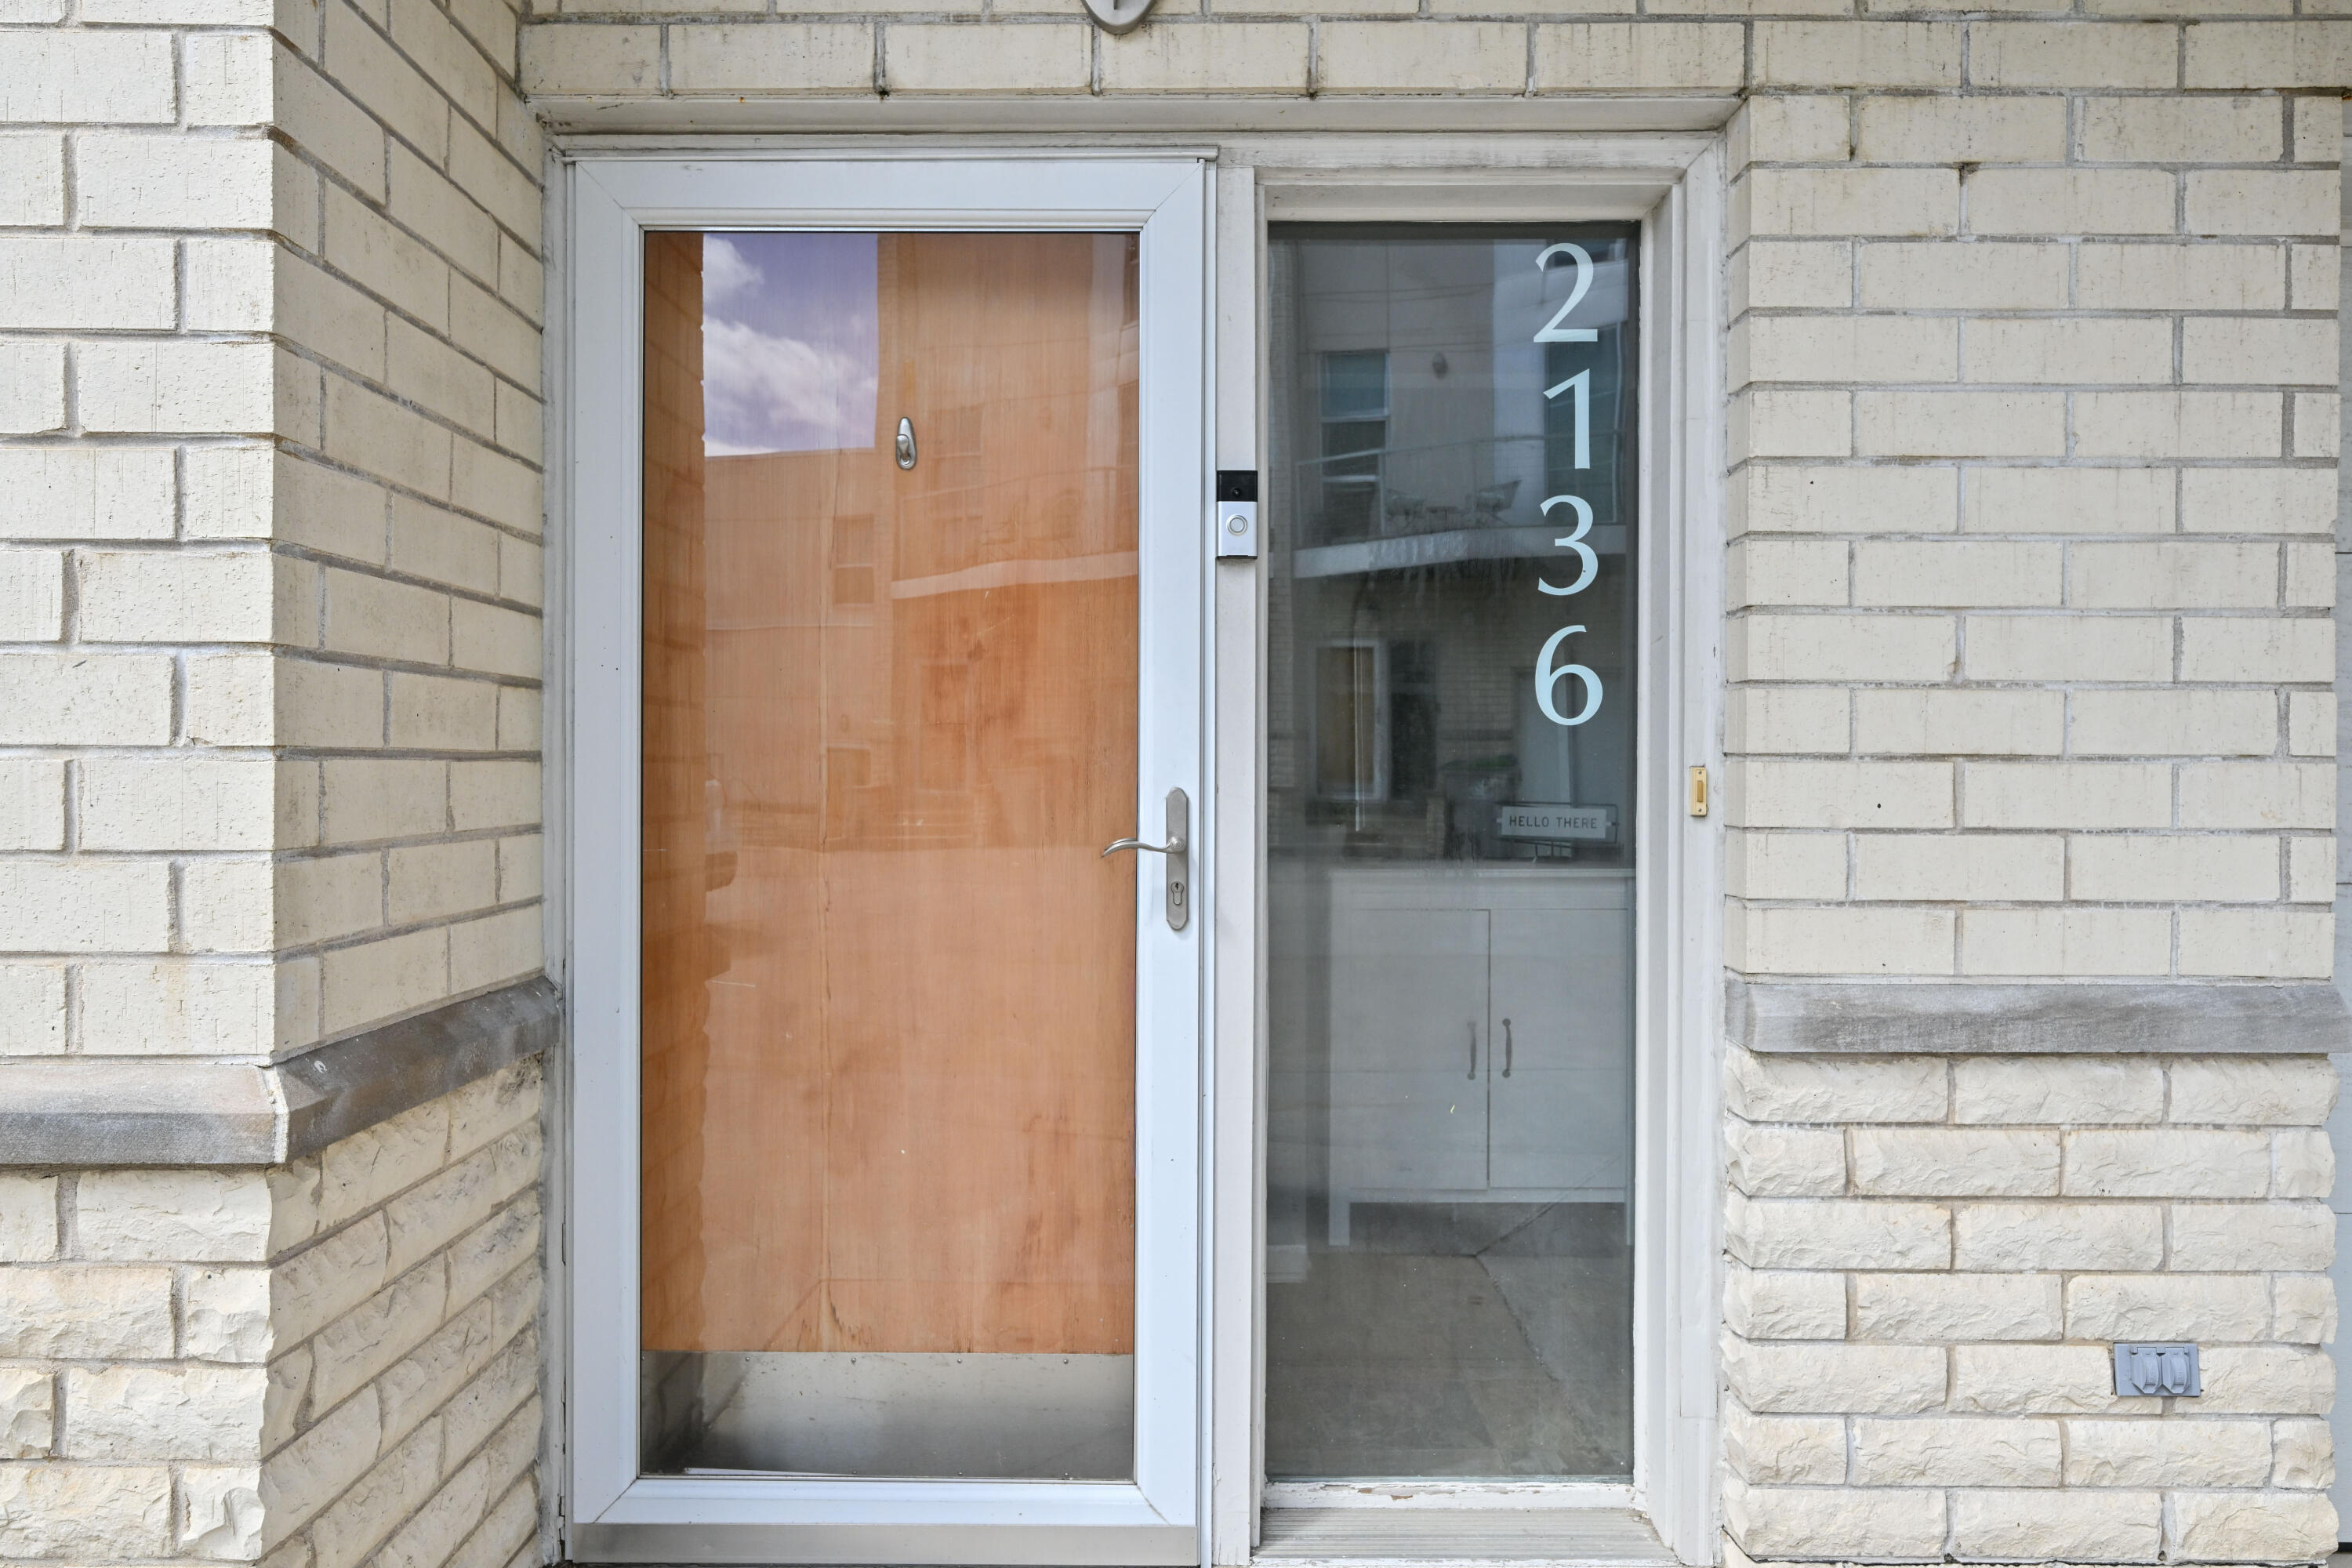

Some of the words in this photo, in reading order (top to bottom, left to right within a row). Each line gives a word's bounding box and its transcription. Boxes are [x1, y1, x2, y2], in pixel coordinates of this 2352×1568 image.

[1533, 242, 1603, 726] 2136
[1509, 815, 1550, 828] HELLO
[1556, 816, 1598, 829] THERE
